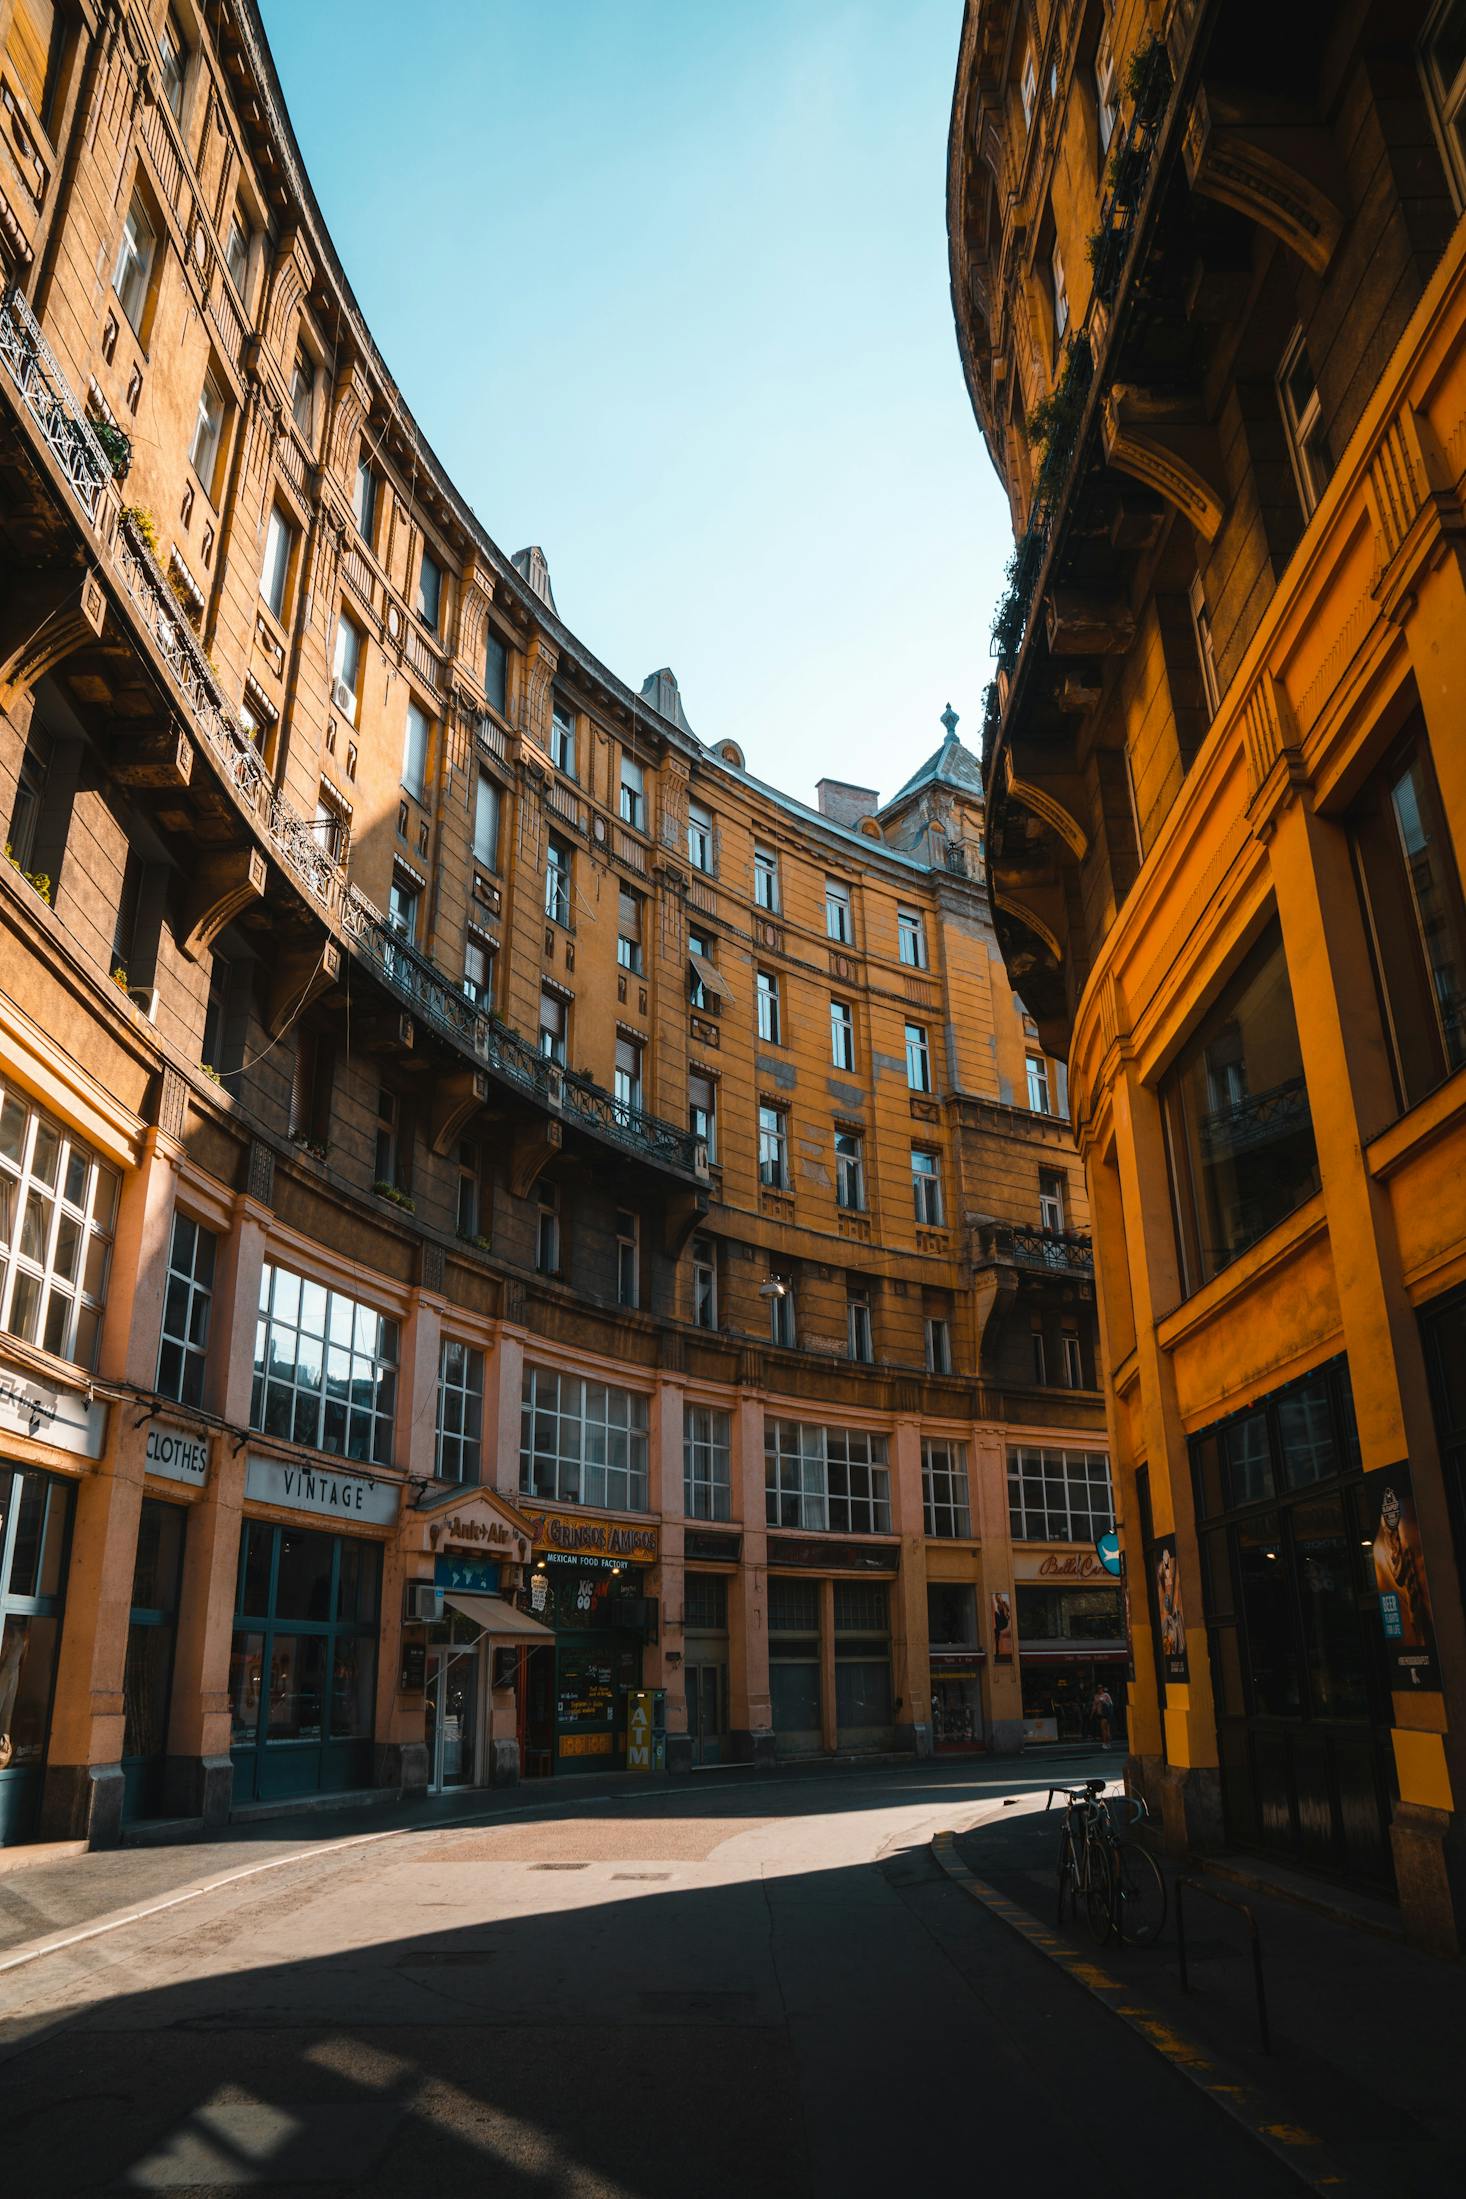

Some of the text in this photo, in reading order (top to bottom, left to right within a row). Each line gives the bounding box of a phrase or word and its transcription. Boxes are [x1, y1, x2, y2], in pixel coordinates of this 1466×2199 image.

[147, 1431, 207, 1473] CLOTHES
[284, 1470, 363, 1509] VINTAGE
[547, 1552, 629, 1569] MEXICAN FOOD FACTORY
[629, 1706, 649, 1765] ATM
